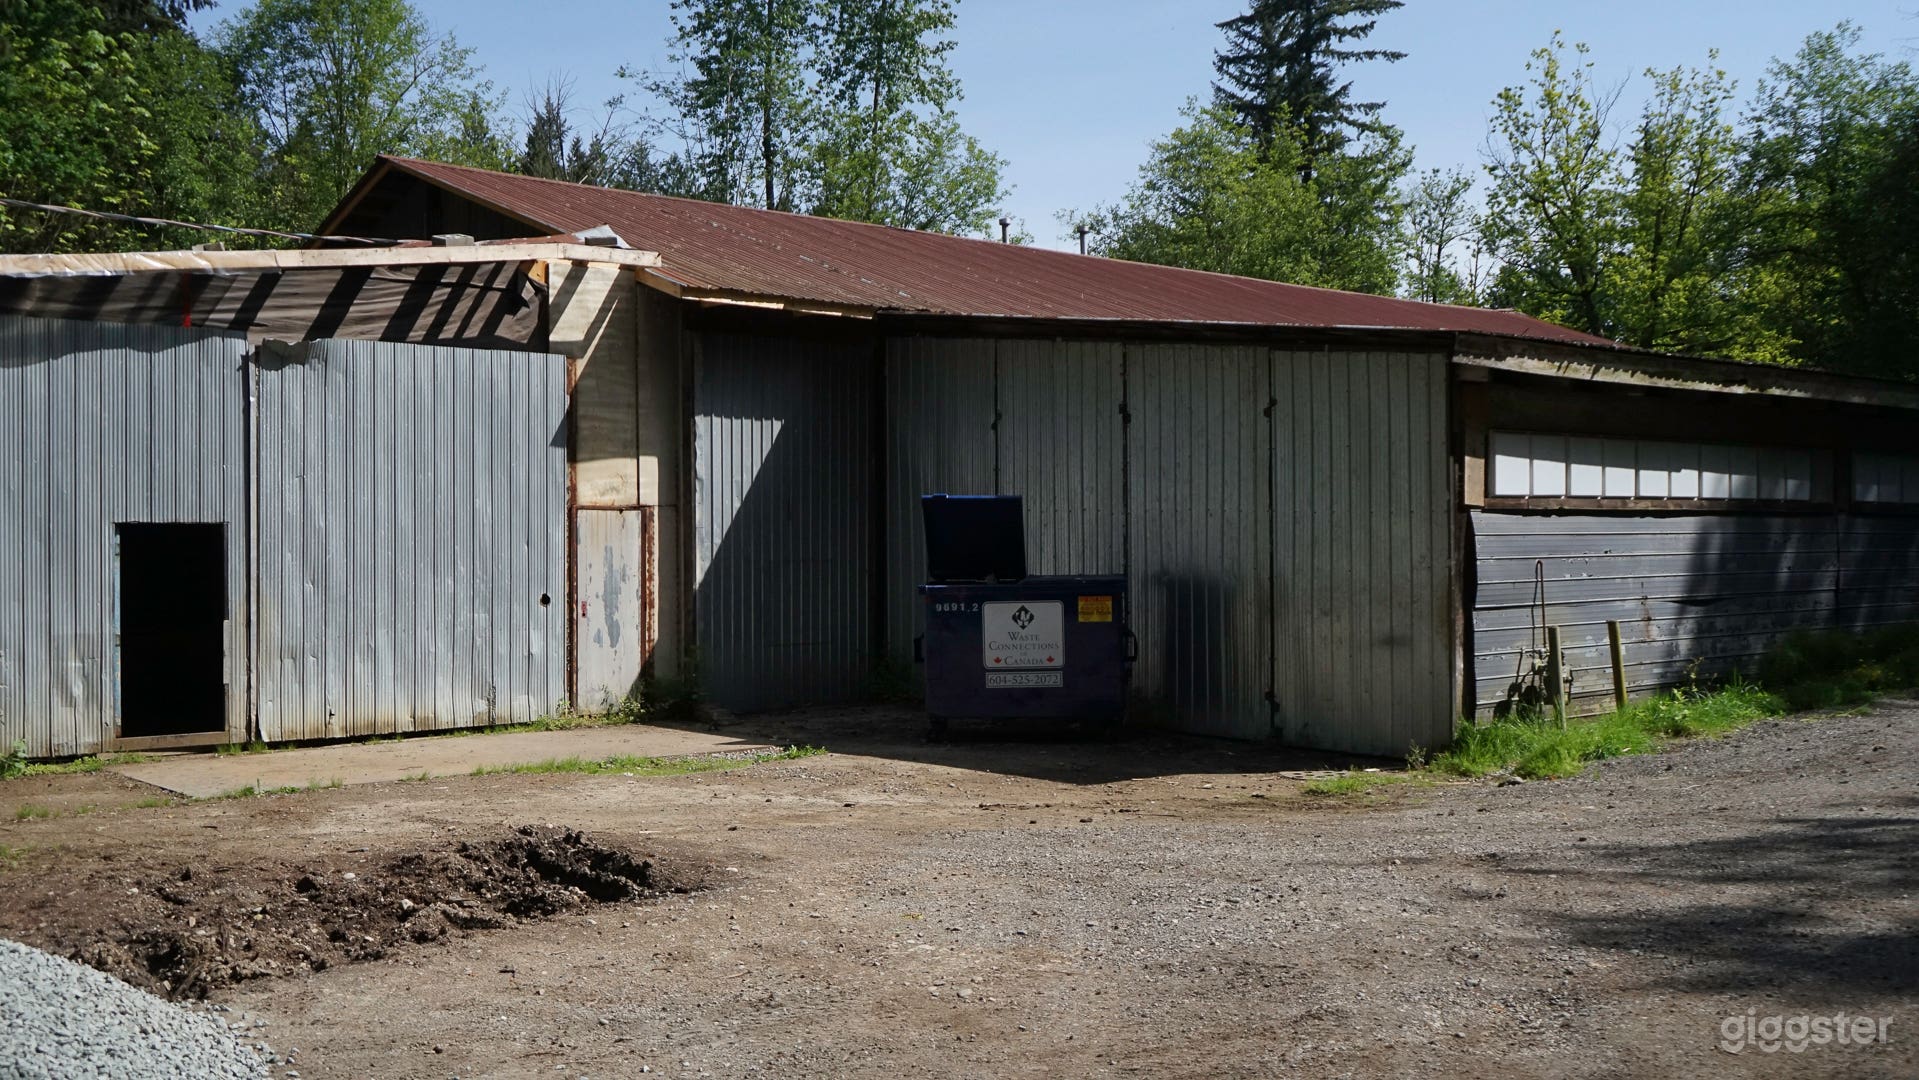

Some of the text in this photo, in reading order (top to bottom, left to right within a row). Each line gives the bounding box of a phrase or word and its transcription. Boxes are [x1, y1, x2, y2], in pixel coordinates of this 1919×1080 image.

[989, 641, 1060, 651] CONNECTIONS
[1005, 656, 1044, 666] CANADA
[989, 675, 1059, 685] 604-525-2072
